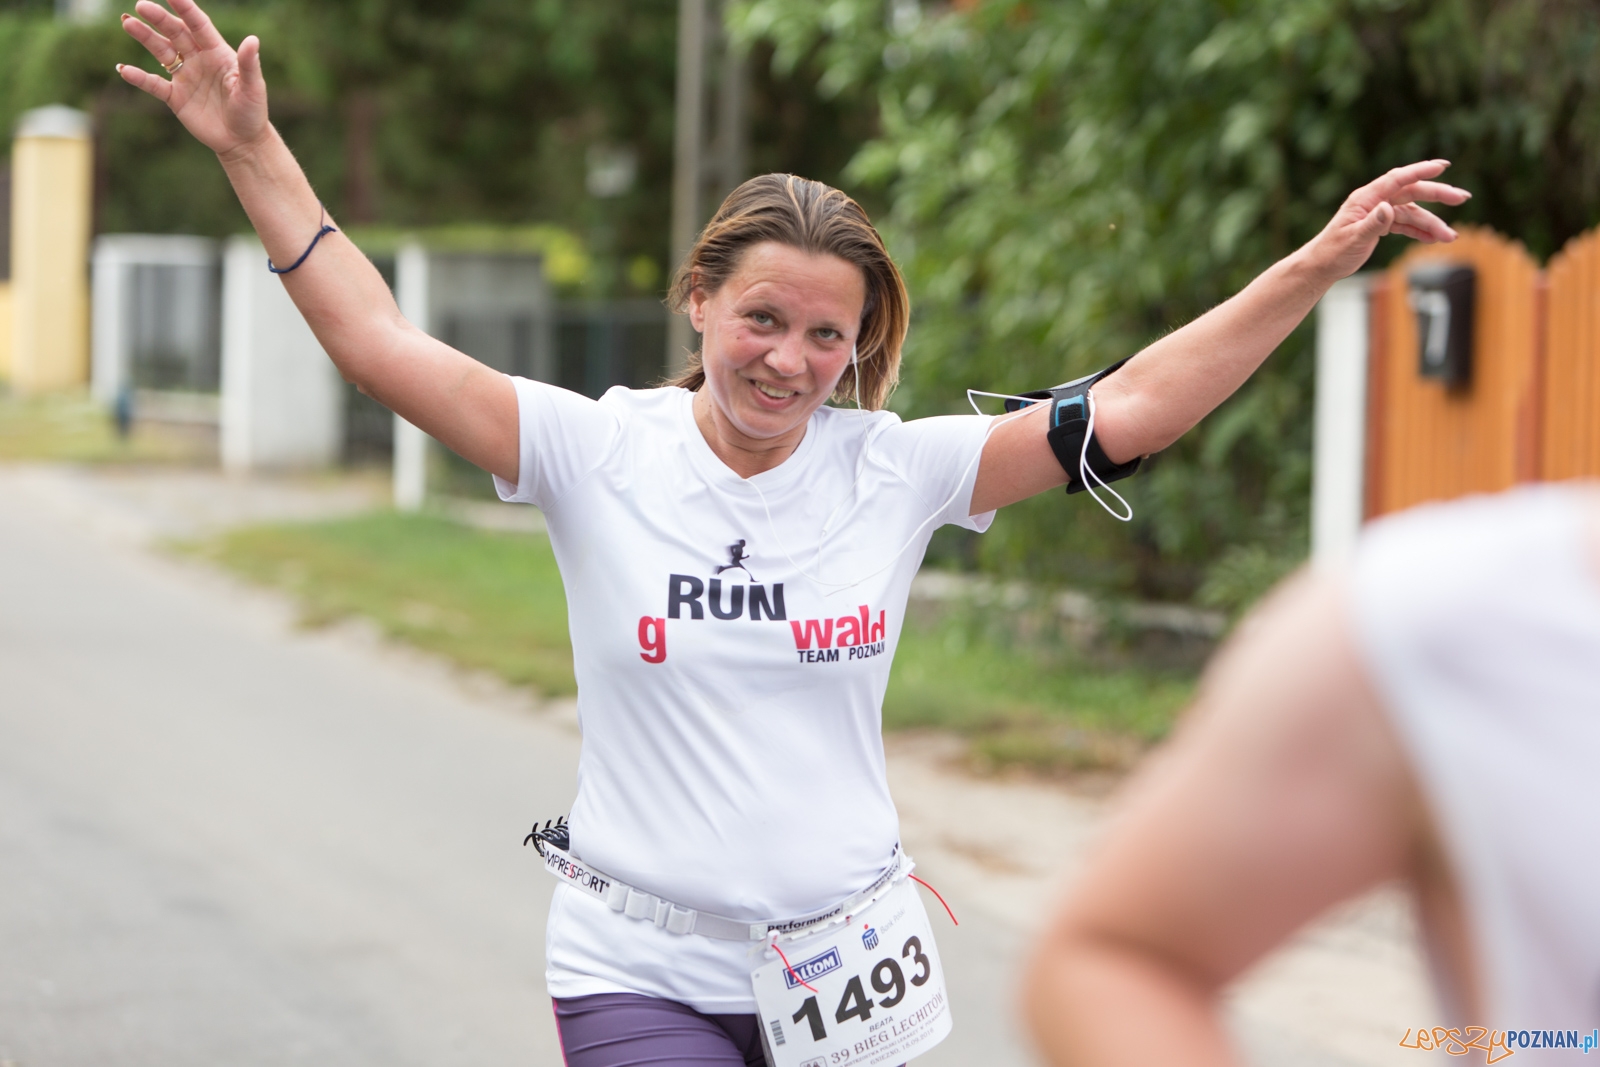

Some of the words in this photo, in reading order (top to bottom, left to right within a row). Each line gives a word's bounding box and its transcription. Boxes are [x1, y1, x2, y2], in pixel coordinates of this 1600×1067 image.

[667, 573, 788, 622] RUN
[637, 615, 667, 664] g
[789, 604, 886, 650] wald
[797, 648, 840, 664] TEAM
[791, 935, 931, 1042] 1493
[869, 1016, 894, 1033] BEATA
[830, 1048, 850, 1065] 39
[854, 1030, 890, 1055] BIEG
